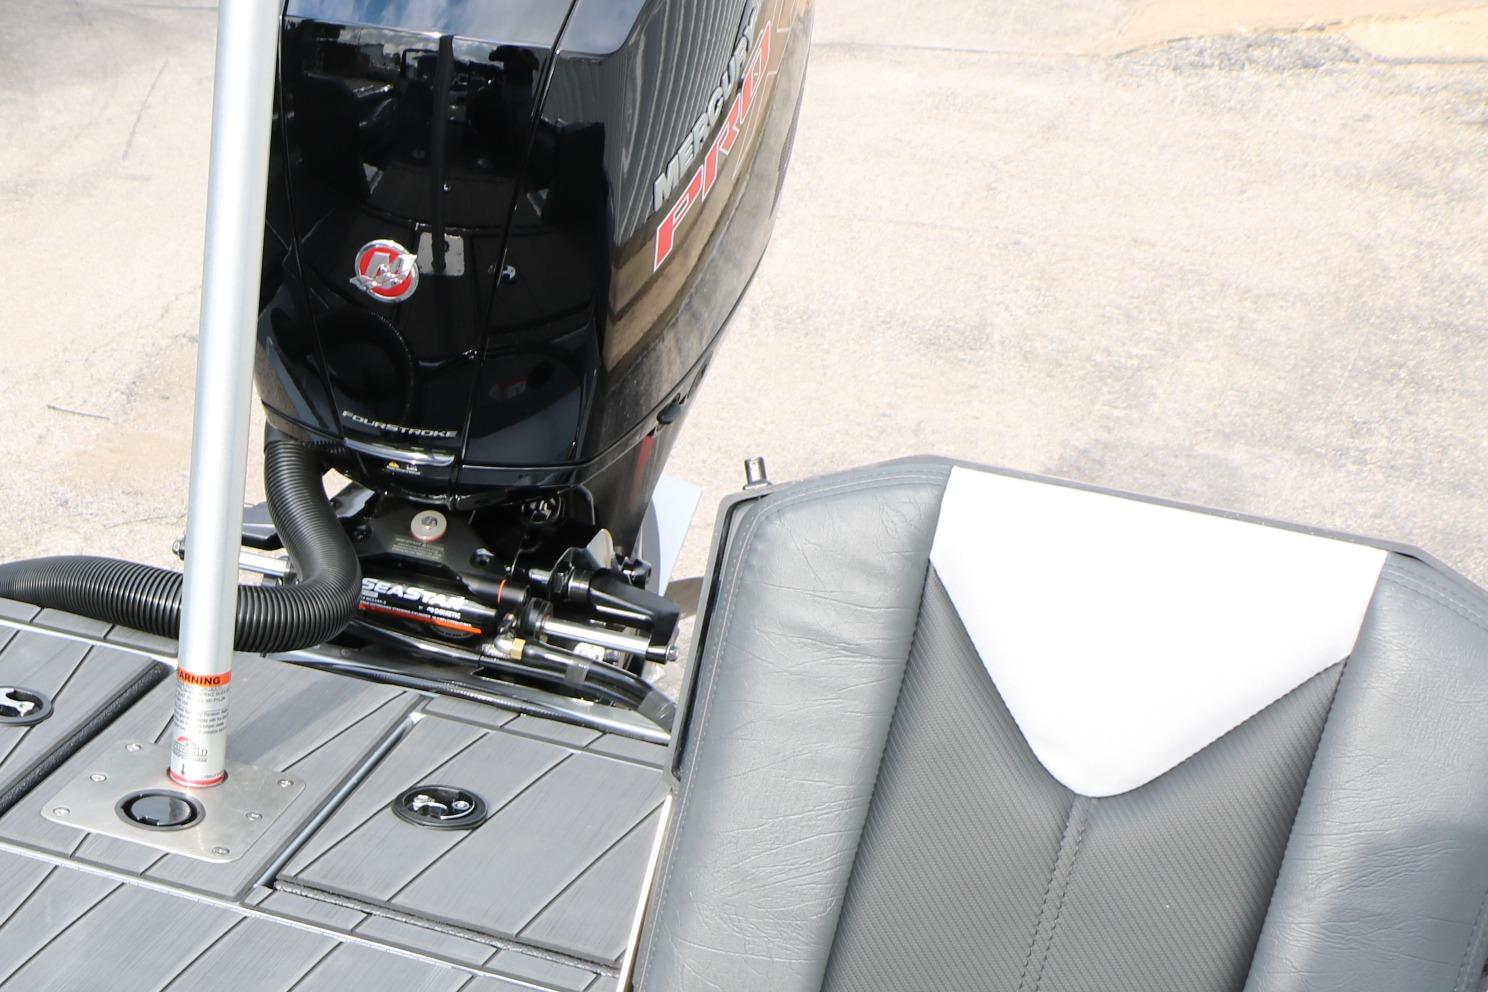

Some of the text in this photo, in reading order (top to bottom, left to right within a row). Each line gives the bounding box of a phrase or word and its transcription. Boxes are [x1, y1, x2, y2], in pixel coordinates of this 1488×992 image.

[653, 7, 757, 213] MERCURY
[654, 20, 770, 272] PRO
[342, 410, 457, 437] FOURSTROKE
